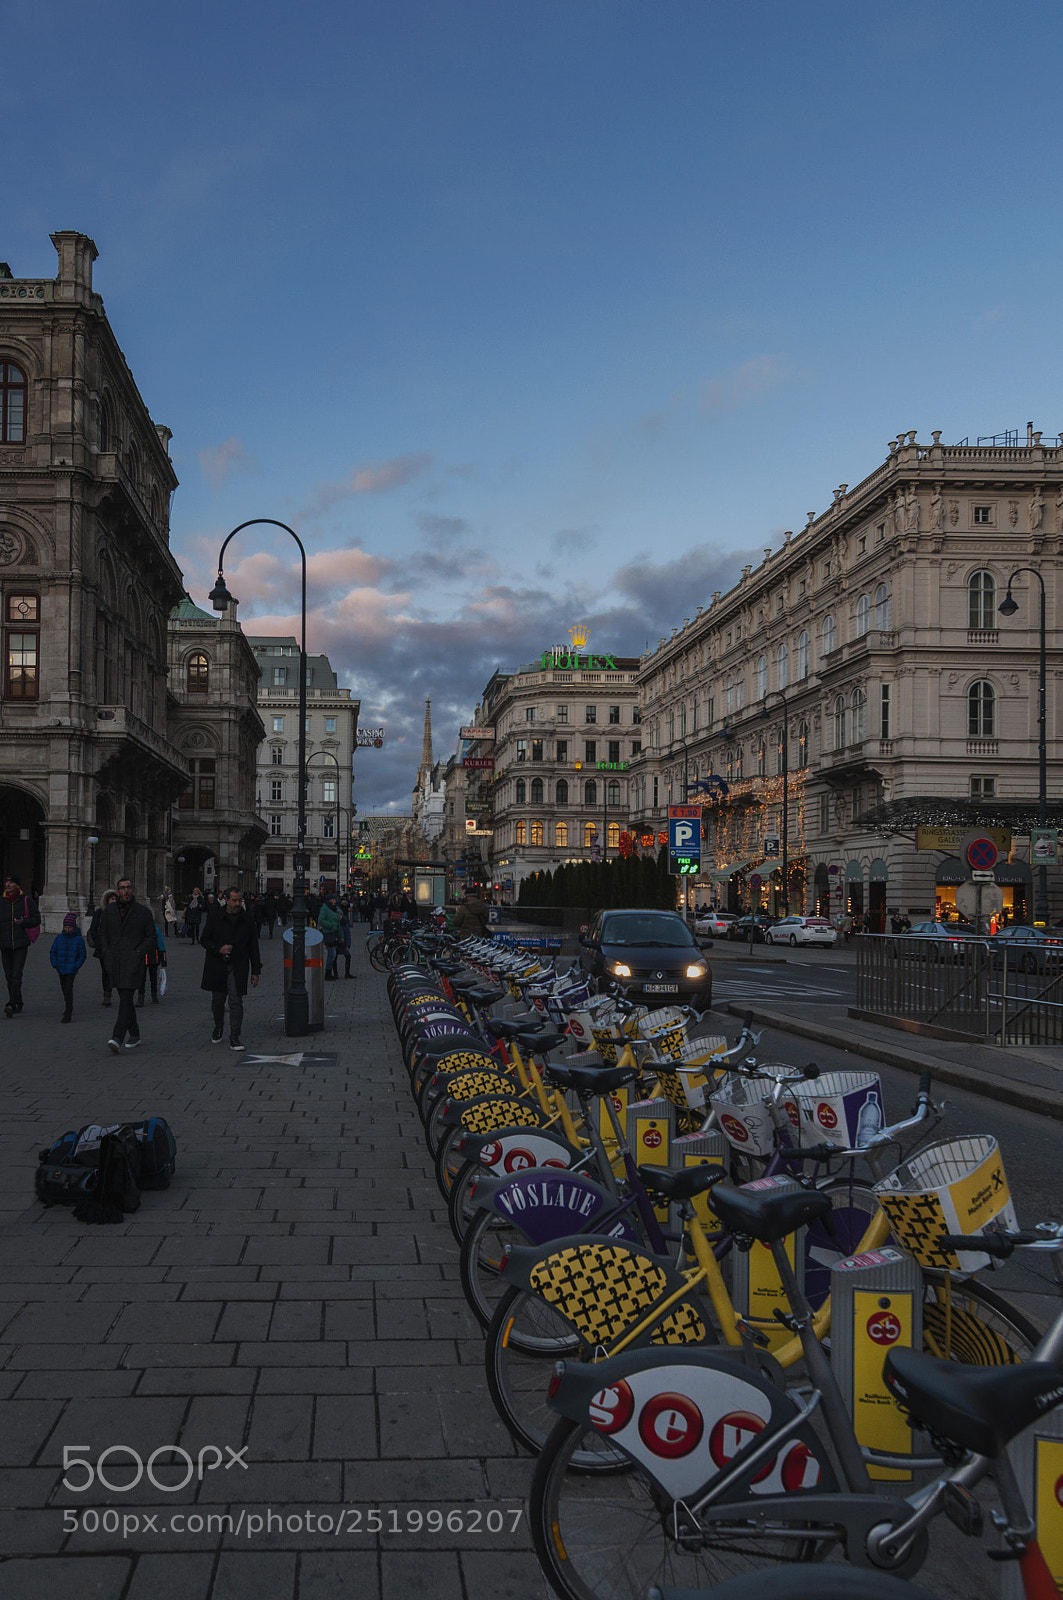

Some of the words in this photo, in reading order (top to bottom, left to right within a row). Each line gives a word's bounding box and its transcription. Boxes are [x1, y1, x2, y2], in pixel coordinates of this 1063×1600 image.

[540, 654, 619, 670] ROLEX
[597, 762, 631, 771] ROLE
[675, 826, 693, 847] P
